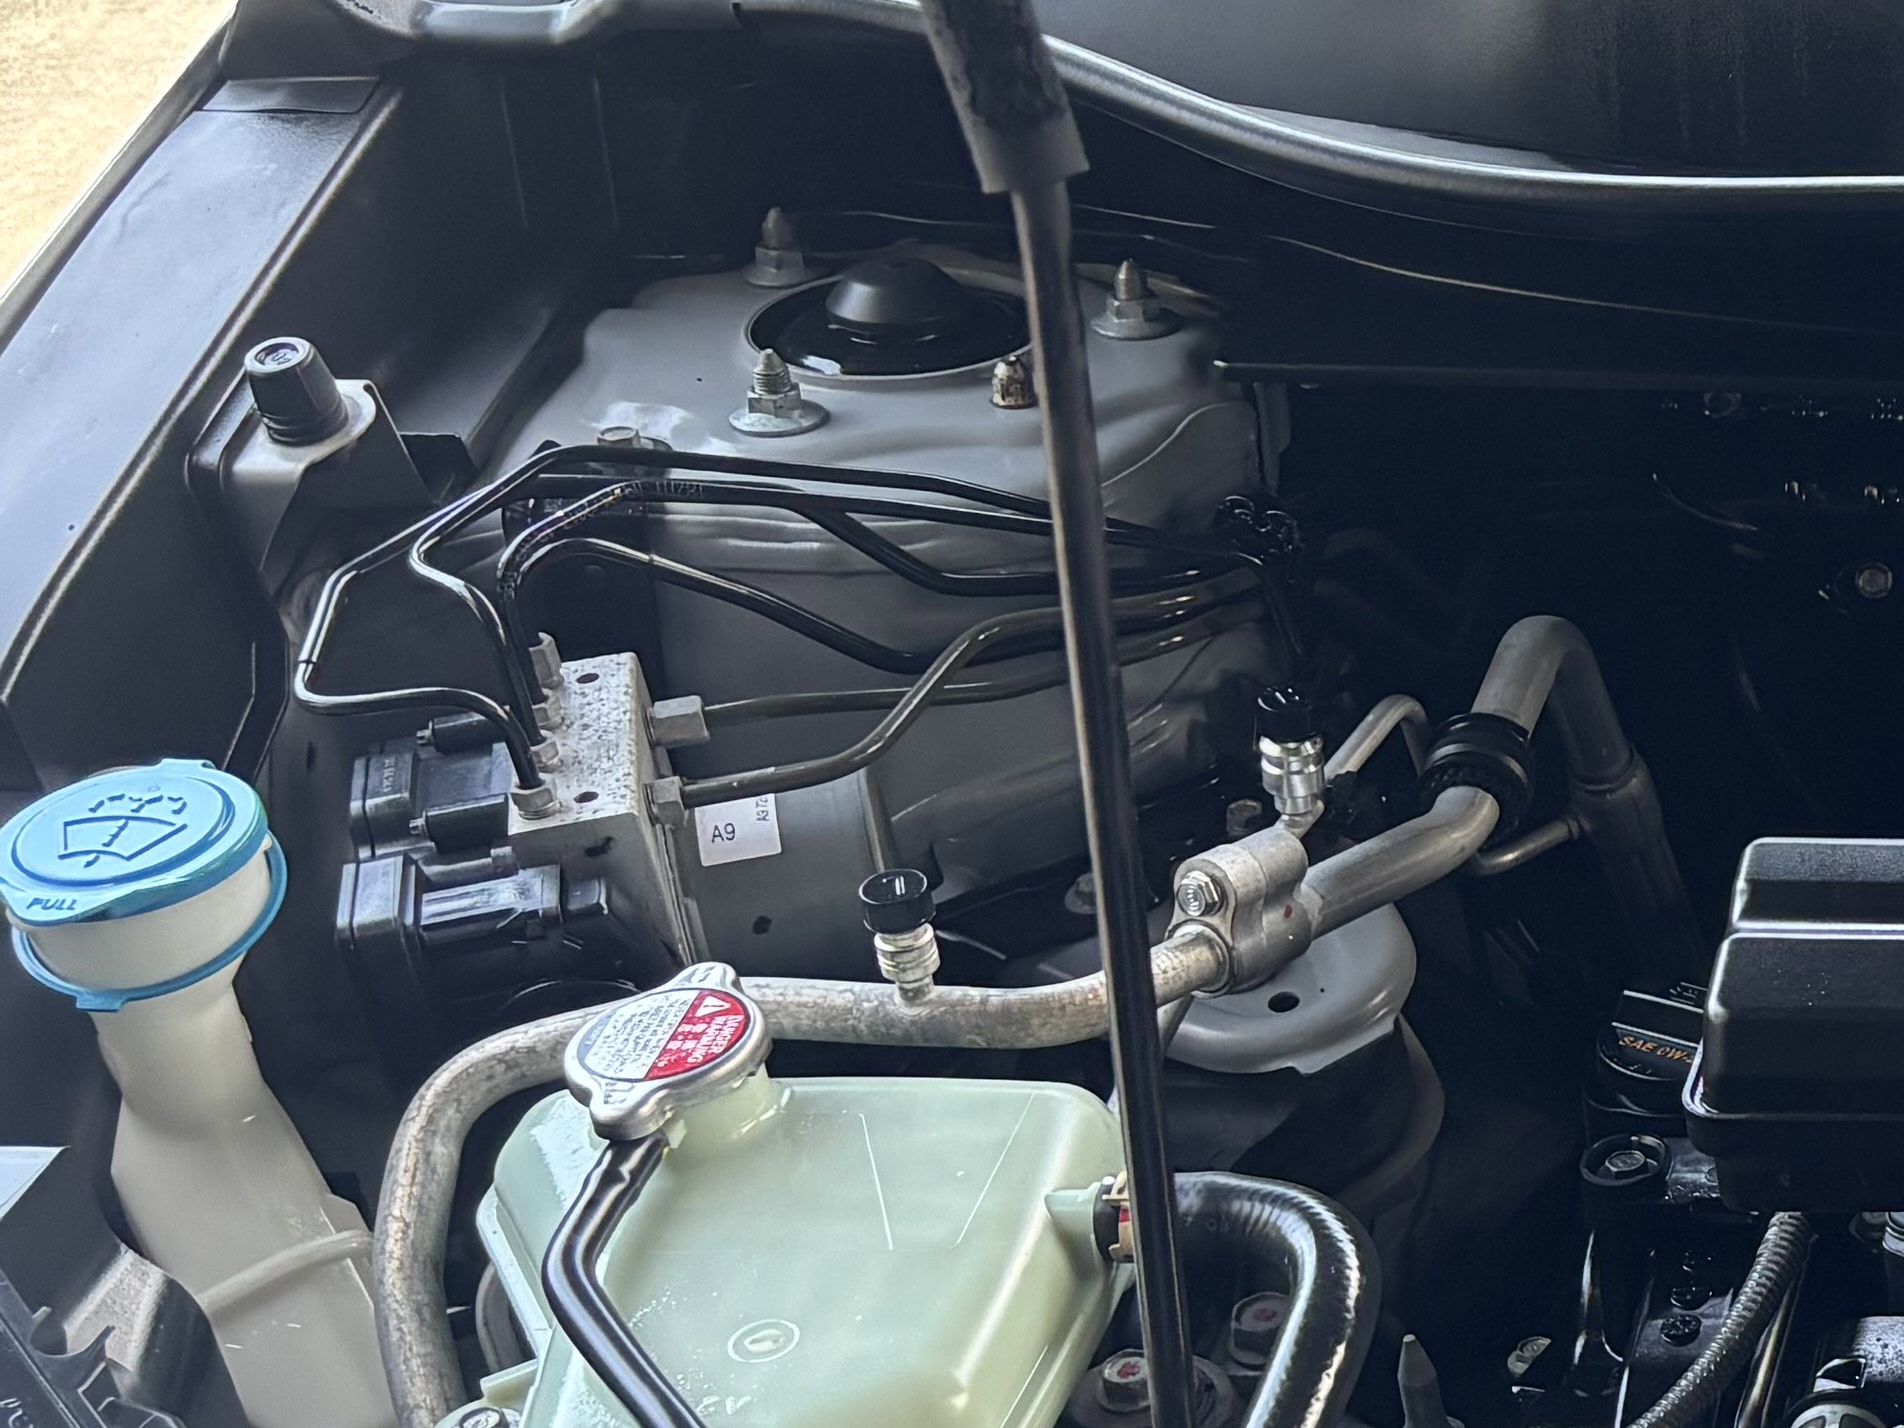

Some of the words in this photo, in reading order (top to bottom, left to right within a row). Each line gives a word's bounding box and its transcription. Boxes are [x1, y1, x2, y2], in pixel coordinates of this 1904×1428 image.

[711, 822, 736, 844] A9
[26, 897, 78, 911] PULL
[687, 1016, 728, 1063] WARNING
[707, 1014, 745, 1053] DANGER
